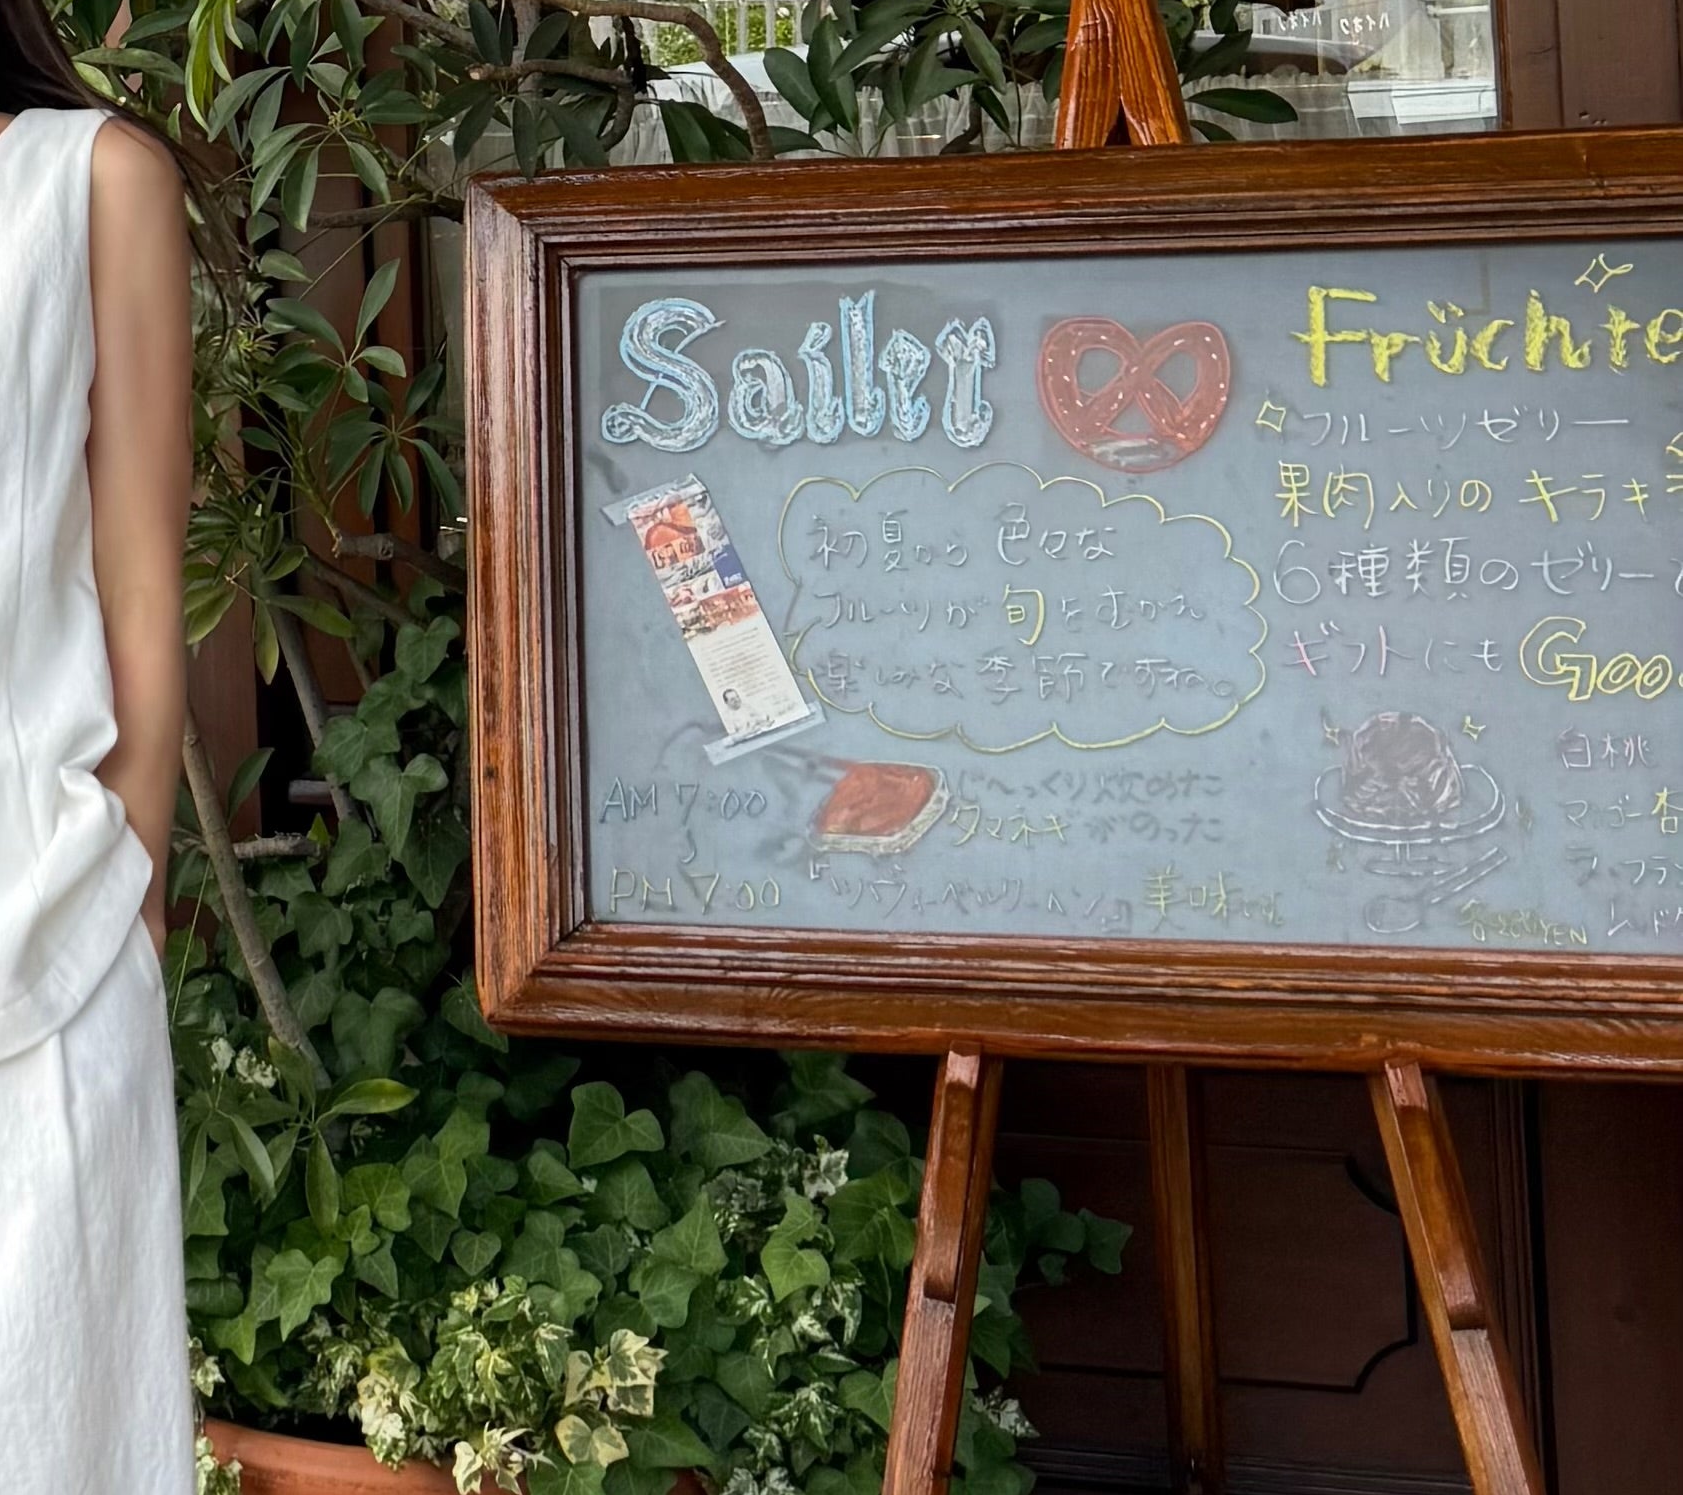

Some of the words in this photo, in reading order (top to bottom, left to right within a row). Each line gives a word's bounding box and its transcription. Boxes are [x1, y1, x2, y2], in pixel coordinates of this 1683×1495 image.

[1302, 404, 1630, 451] フルーツゼリー
[1519, 616, 1683, 702] Goo
[598, 777, 659, 824] AM
[610, 867, 675, 913] PM
